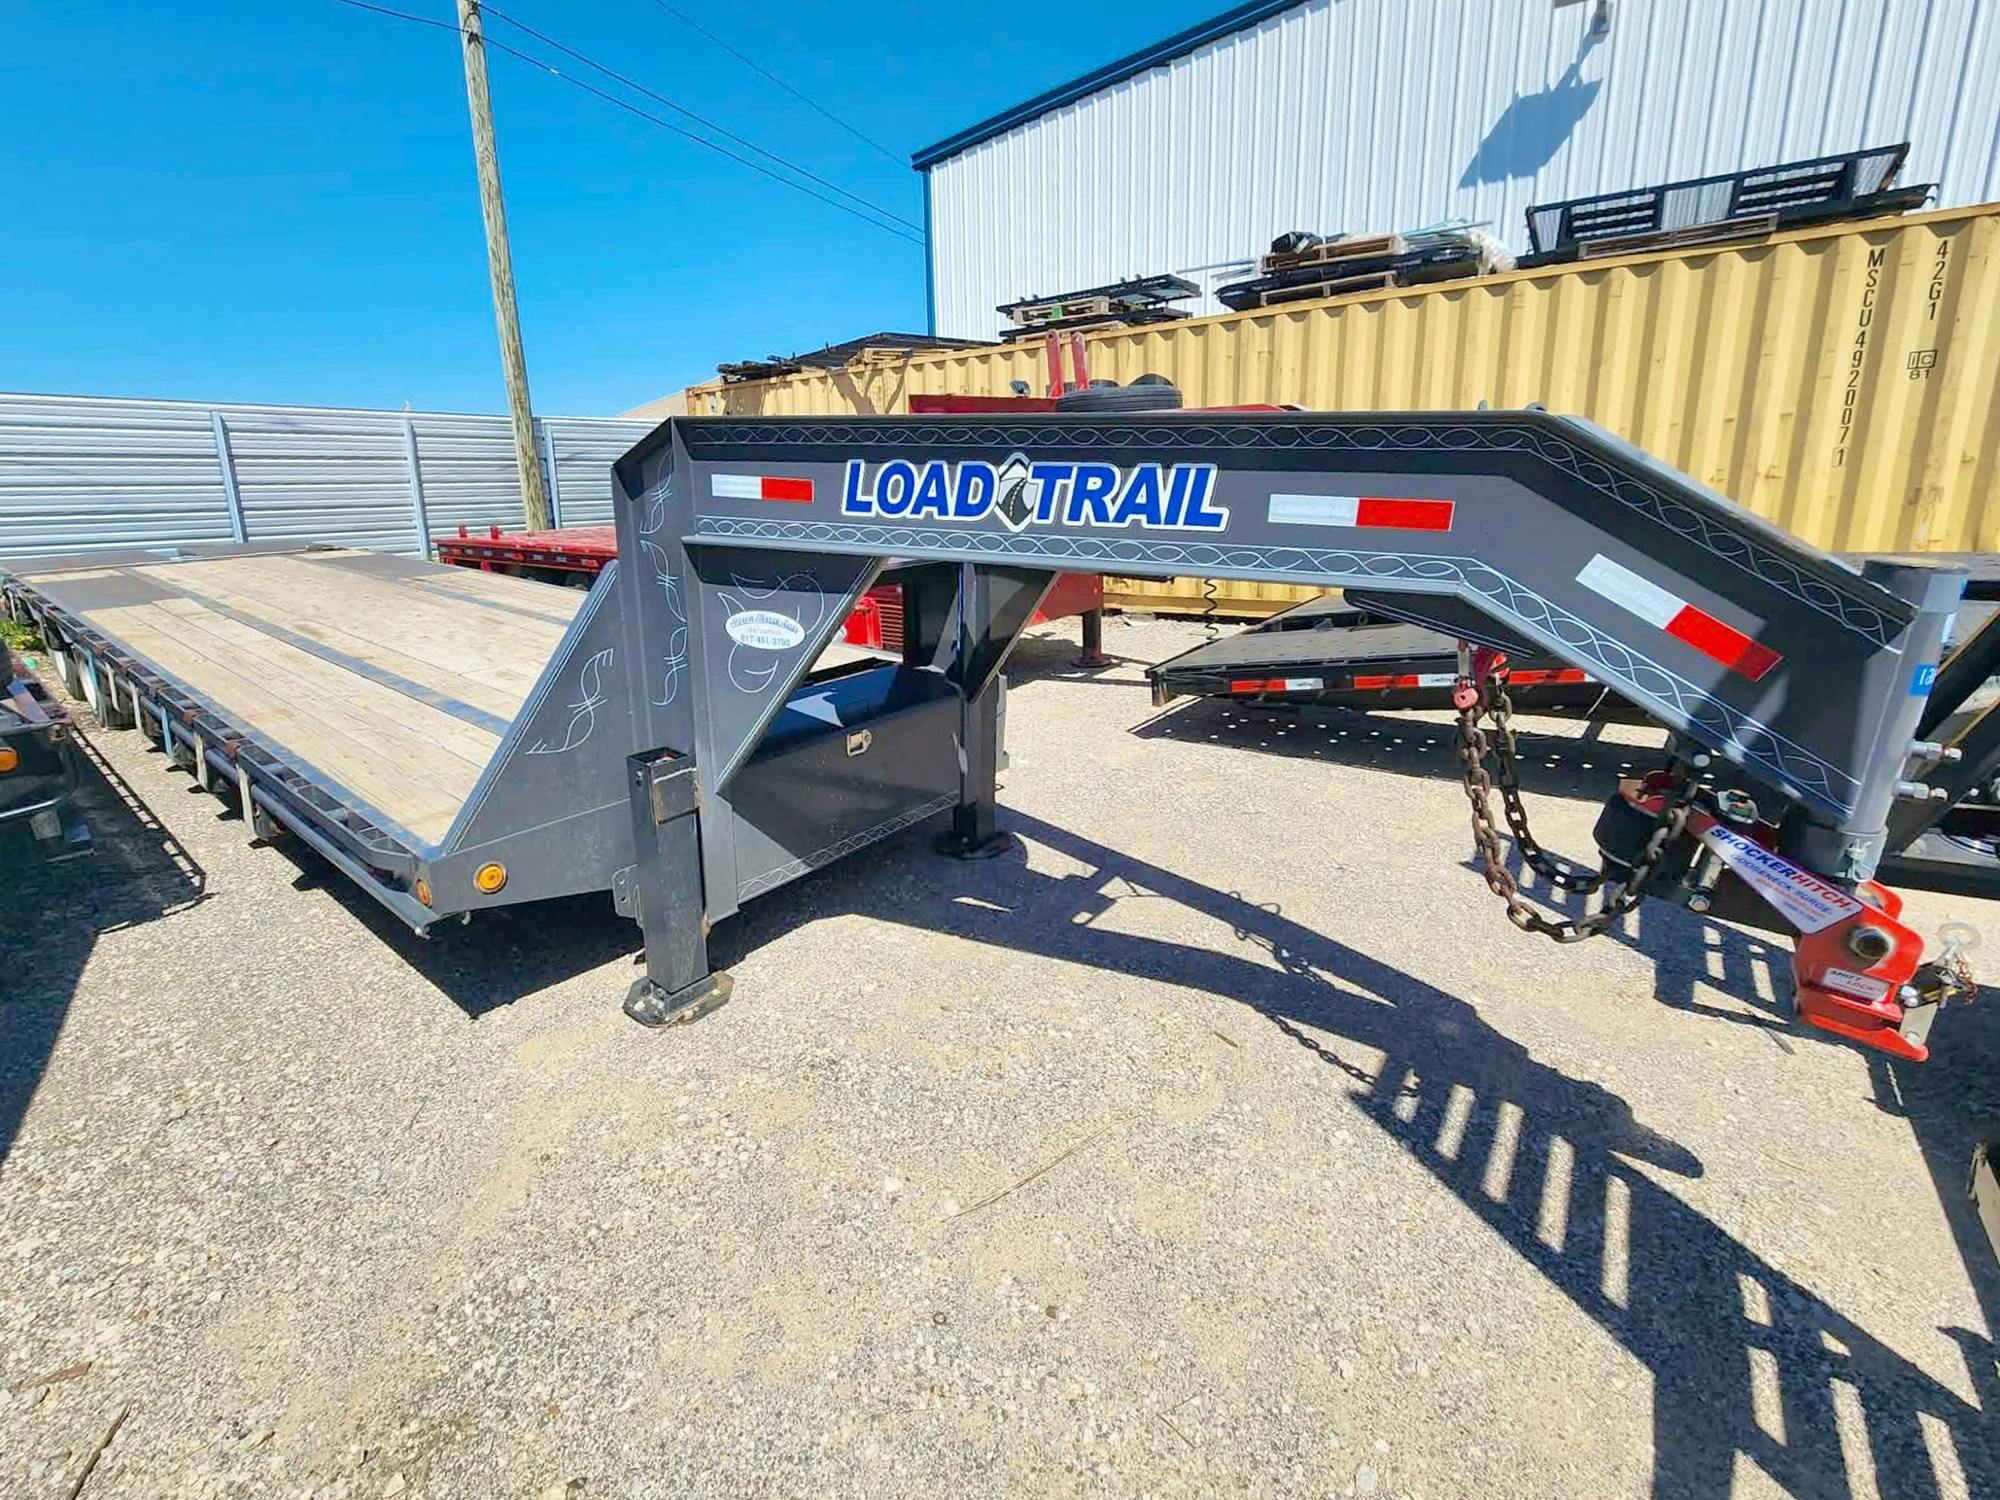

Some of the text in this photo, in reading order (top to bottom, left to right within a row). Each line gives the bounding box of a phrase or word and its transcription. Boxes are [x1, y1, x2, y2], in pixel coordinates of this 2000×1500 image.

[1928, 239, 1949, 321] 42G1
[1909, 370, 1930, 380] 81
[842, 459, 1231, 533] LOAD TRAIL
